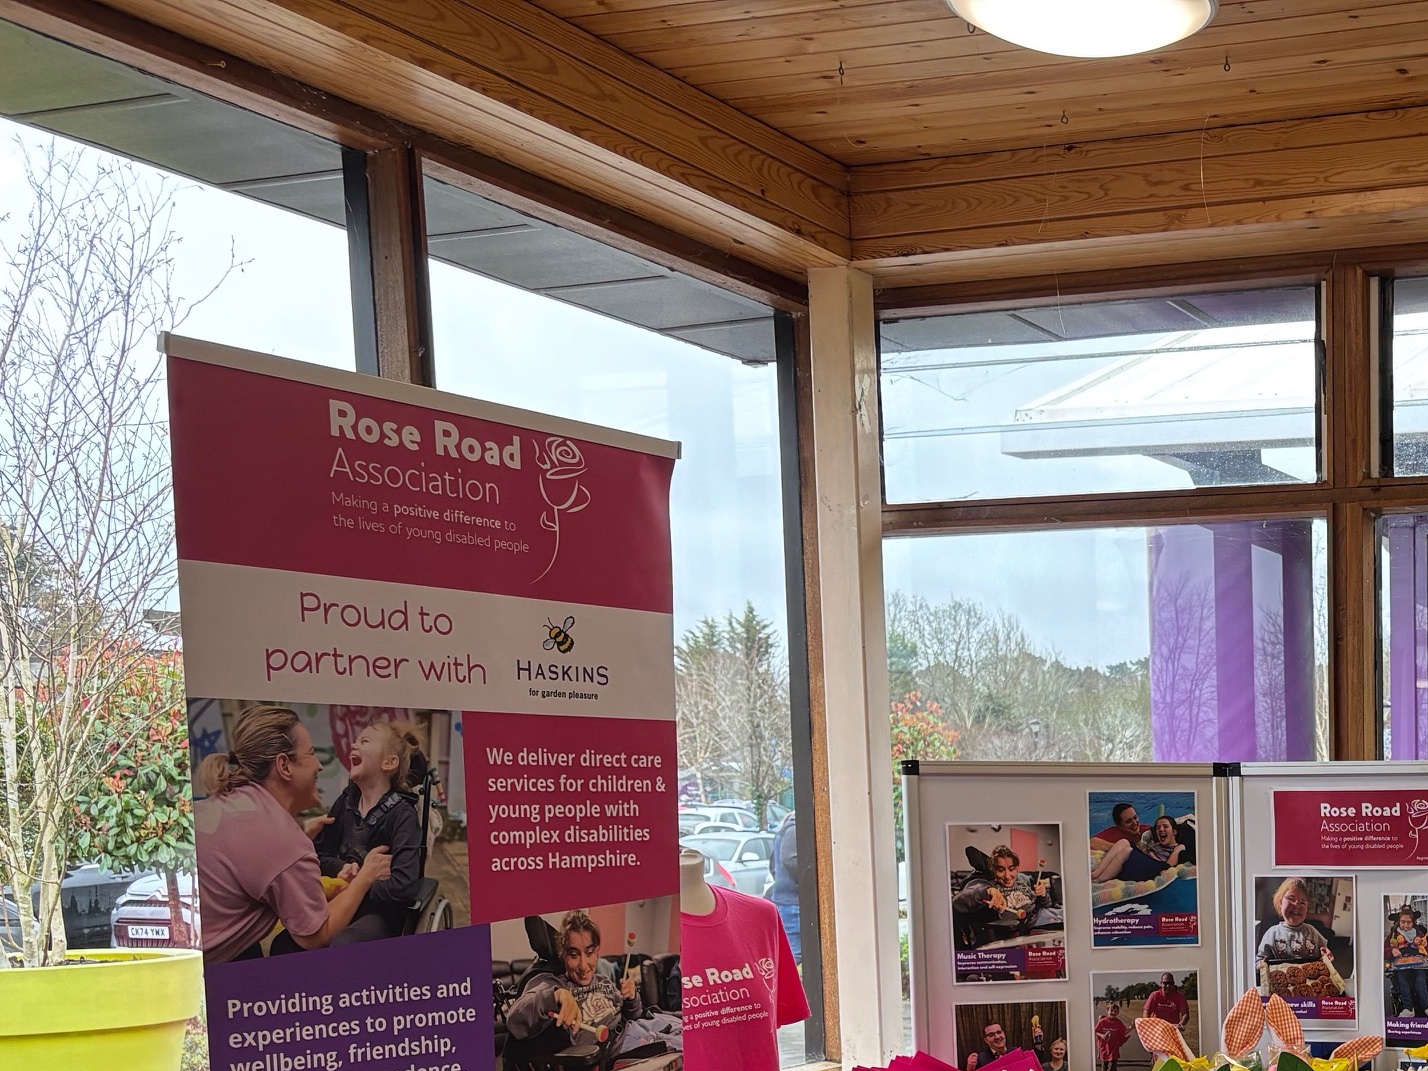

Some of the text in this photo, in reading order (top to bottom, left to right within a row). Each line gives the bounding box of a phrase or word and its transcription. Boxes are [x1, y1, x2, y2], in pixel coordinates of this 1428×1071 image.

[328, 398, 521, 470] Rose Road
[330, 447, 499, 504] Association
[331, 491, 516, 532] Making a positive difference to
[333, 513, 530, 555] the lives of young disabled people
[299, 591, 453, 636] Proud to
[265, 647, 486, 685] partner with
[516, 659, 609, 686] HASKINS
[528, 687, 599, 700] for garden pleasure
[485, 747, 662, 768] We deliver direct care
[488, 774, 666, 792] services for children &
[488, 799, 639, 824] young people with
[1320, 802, 1401, 817] Rose Road
[490, 824, 650, 849] complex disabilities
[1320, 819, 1391, 832] Association
[491, 849, 640, 872] across Hampshire.
[1093, 917, 1140, 925] Hydrotherapy
[957, 952, 1006, 960] Music Therapy
[681, 963, 754, 989] se Road
[227, 976, 471, 1019] Providing activities and
[682, 987, 750, 1009] sociation
[229, 1006, 476, 1051] experiences to promote
[1386, 1020, 1409, 1030] Making
[348, 1034, 456, 1063] friendship,
